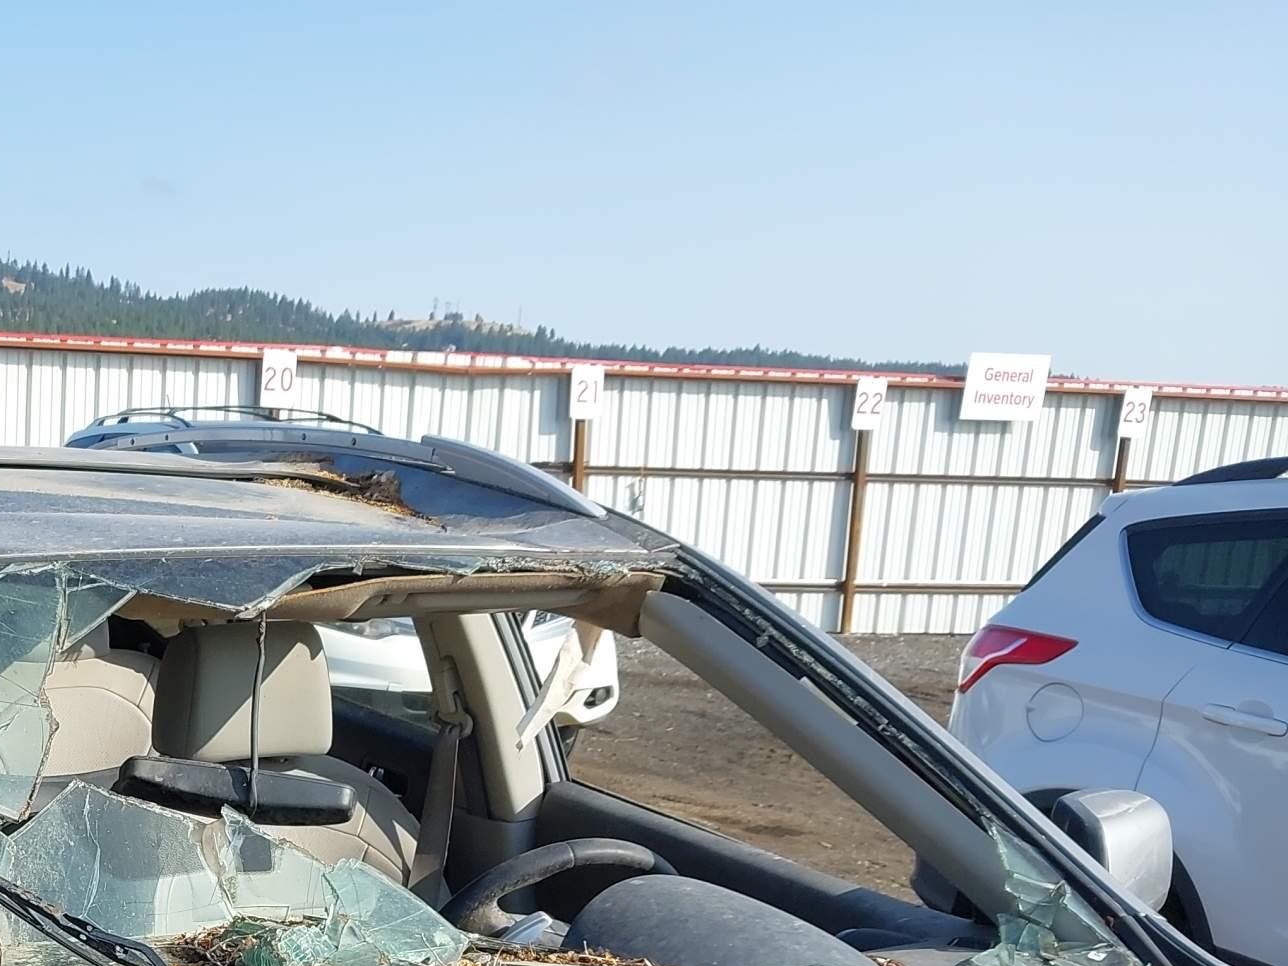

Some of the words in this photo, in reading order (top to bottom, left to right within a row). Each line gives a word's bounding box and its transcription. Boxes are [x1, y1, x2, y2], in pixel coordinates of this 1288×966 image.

[264, 366, 293, 391] 20
[984, 367, 1034, 383] General
[576, 379, 598, 404] 21
[856, 391, 883, 414] 22
[974, 389, 1035, 409] Inventory
[1123, 401, 1146, 423] 23
